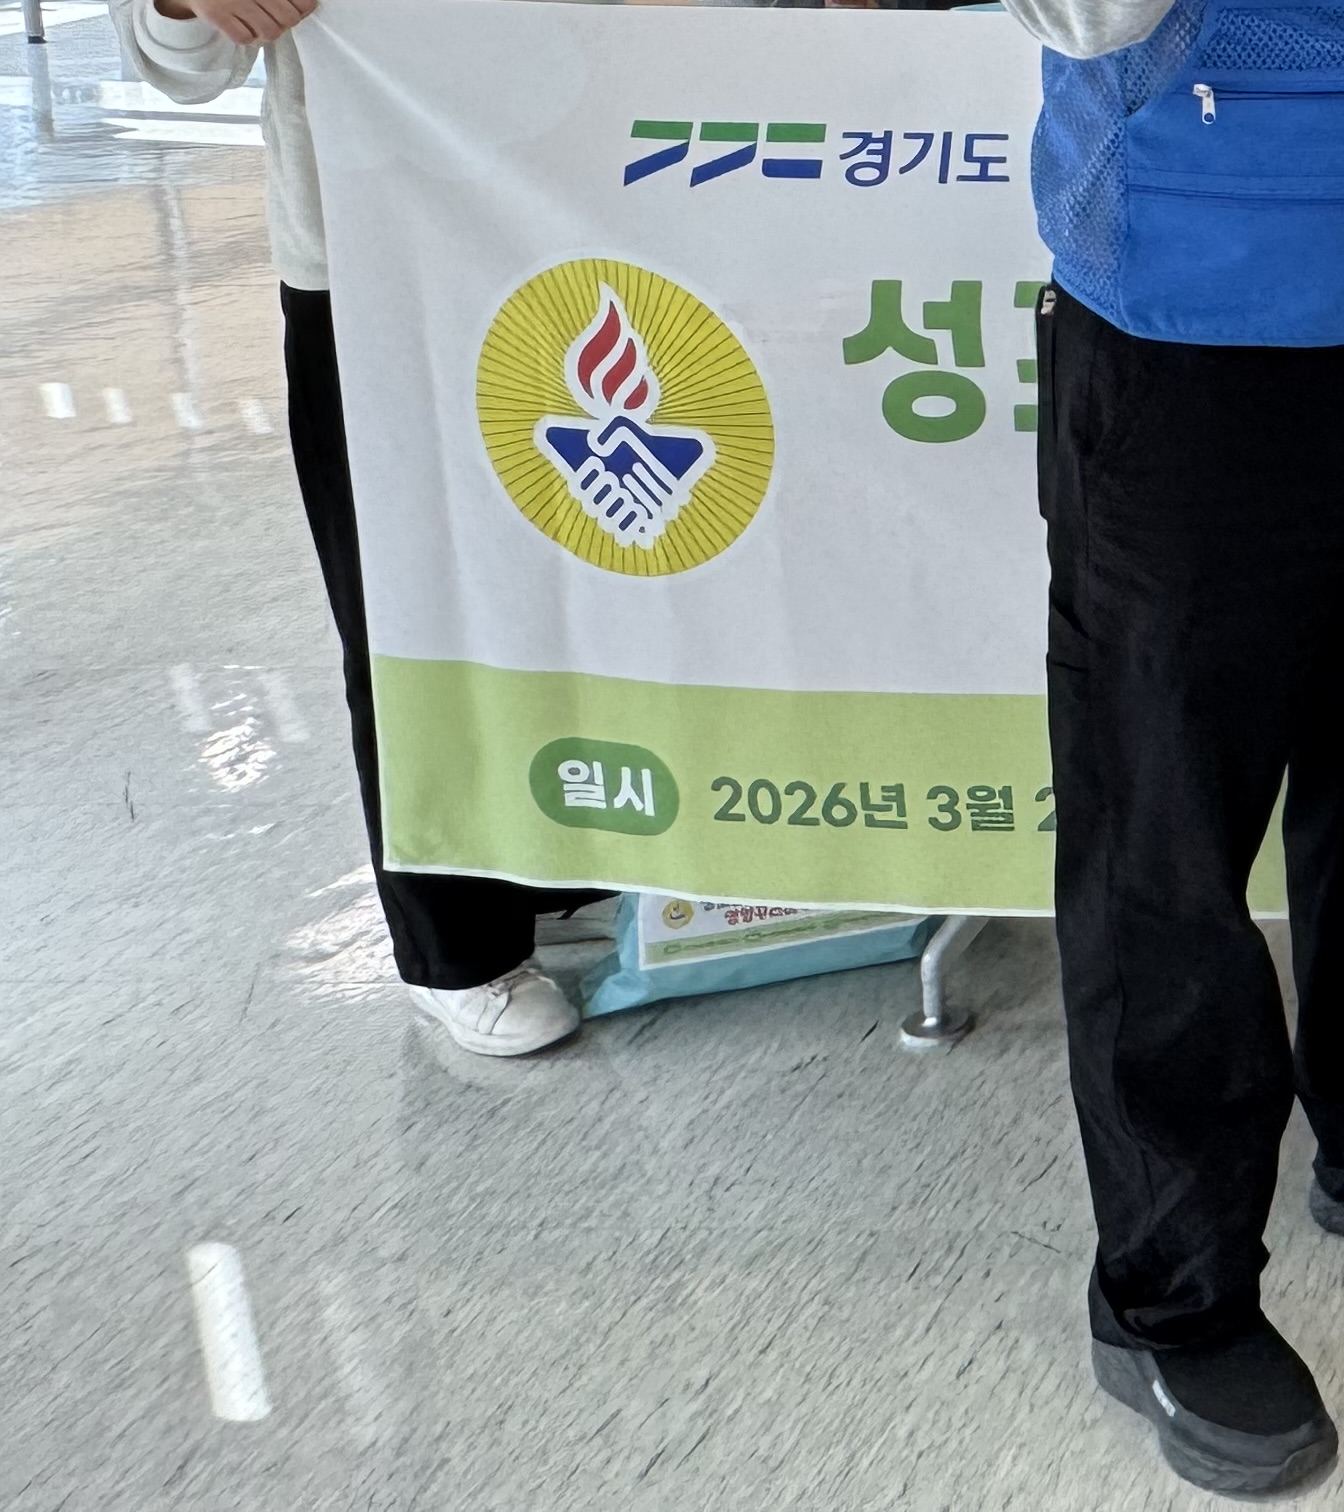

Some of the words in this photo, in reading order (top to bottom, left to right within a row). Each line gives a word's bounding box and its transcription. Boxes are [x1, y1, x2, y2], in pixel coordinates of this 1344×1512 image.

[838, 129, 1011, 188] 경기도
[557, 759, 656, 818] 일시
[710, 776, 909, 831] 2026년
[925, 784, 1017, 833] 3월
